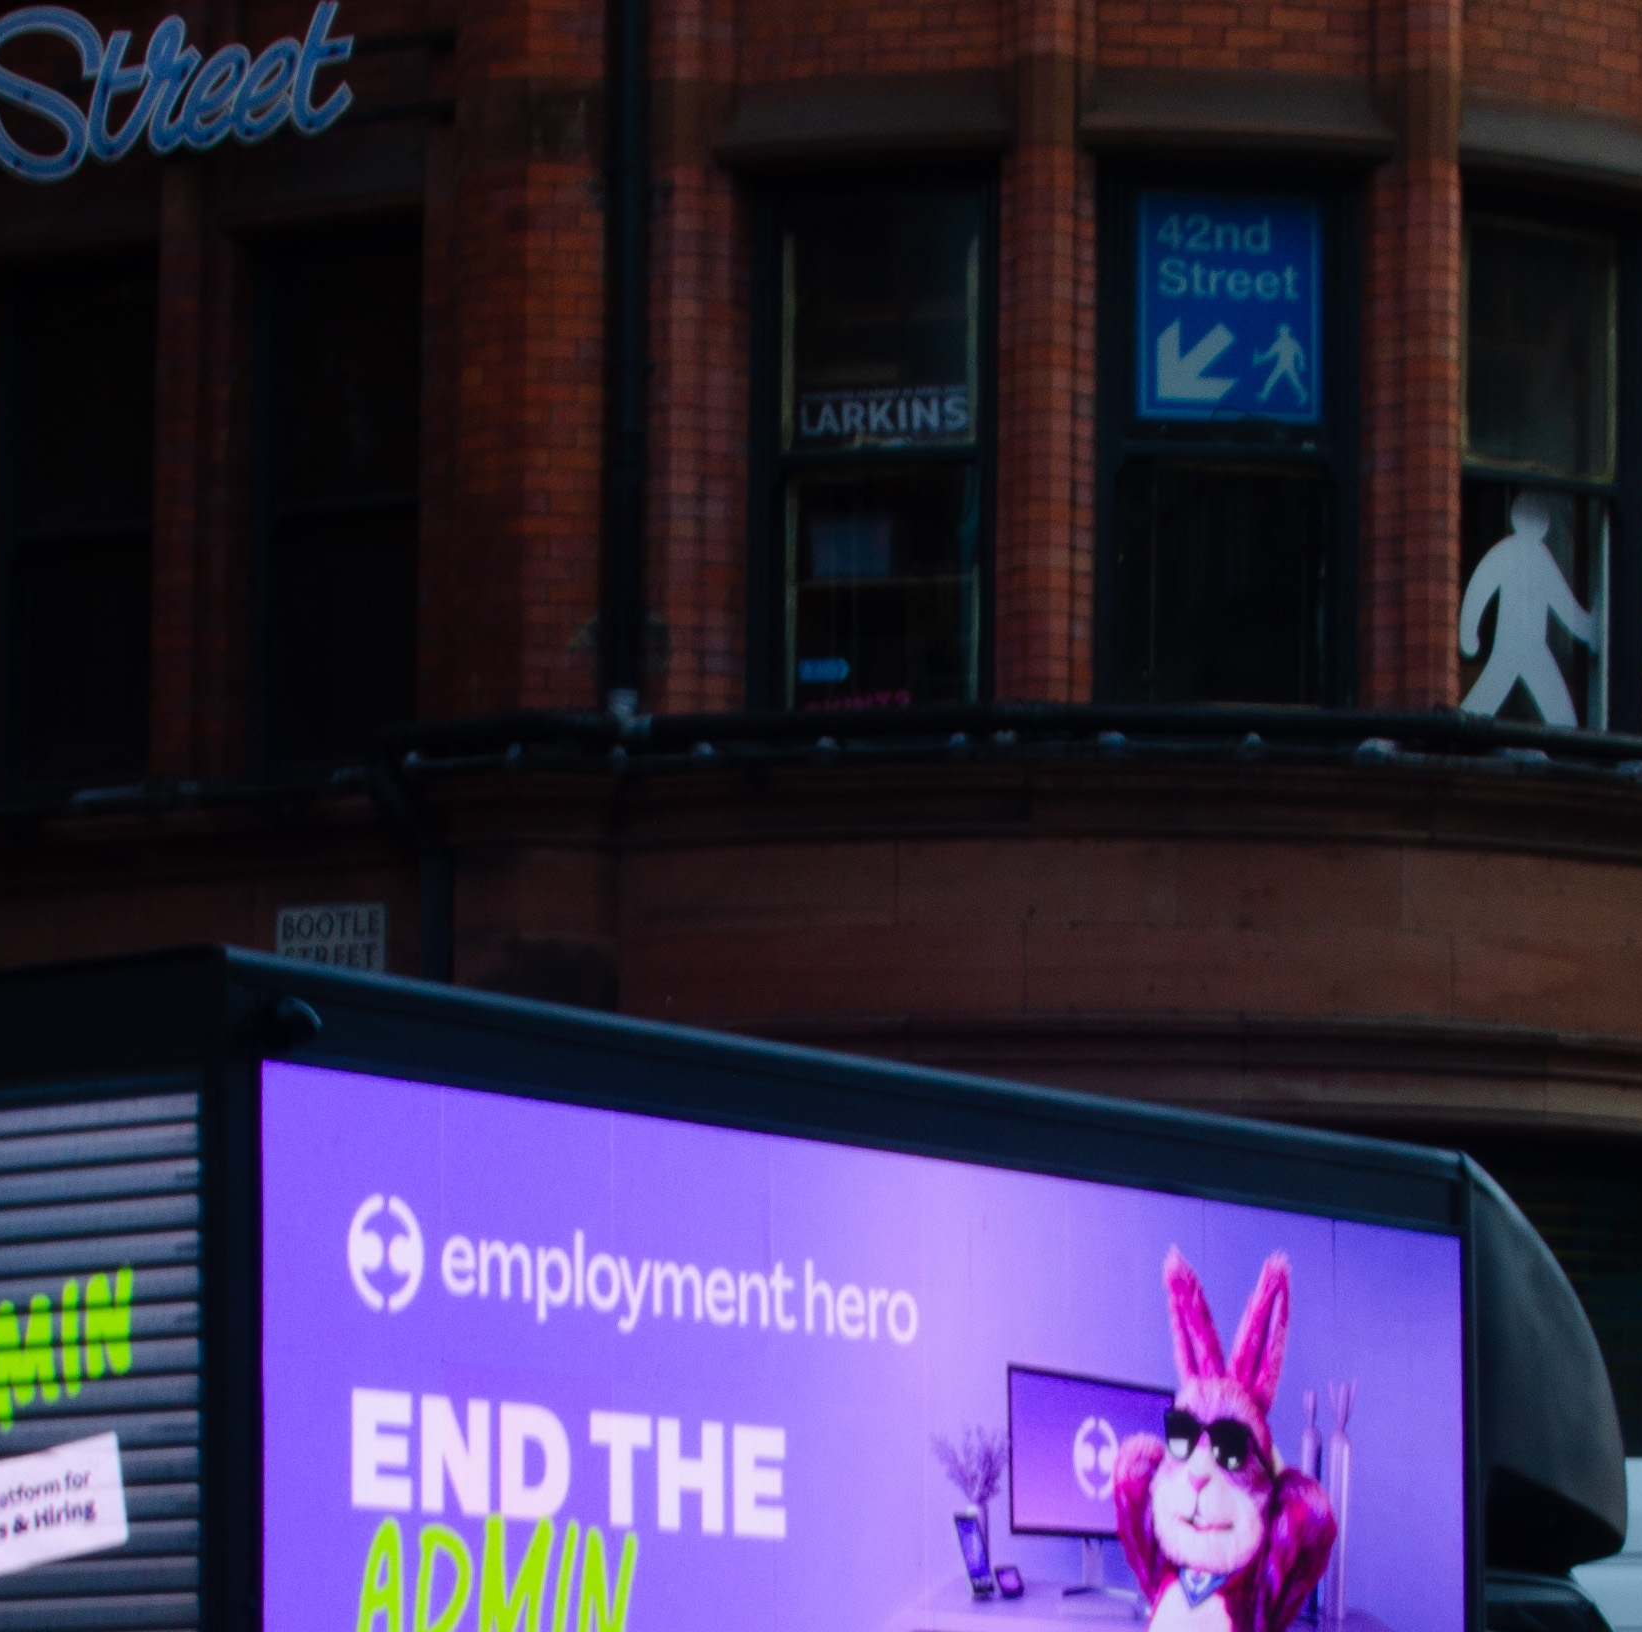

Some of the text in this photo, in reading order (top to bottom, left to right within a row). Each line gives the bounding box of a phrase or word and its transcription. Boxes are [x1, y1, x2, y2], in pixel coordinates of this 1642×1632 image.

[1158, 213, 1271, 254] 42nd
[1159, 257, 1298, 299] Street
[800, 396, 968, 438] LARKINS
[283, 909, 381, 940] BOOTLE
[441, 1229, 919, 1344] employment hero
[65, 1471, 90, 1492] for
[351, 1387, 787, 1539] END THE
[13, 1515, 28, 1533] &
[35, 1500, 96, 1529] Hiring
